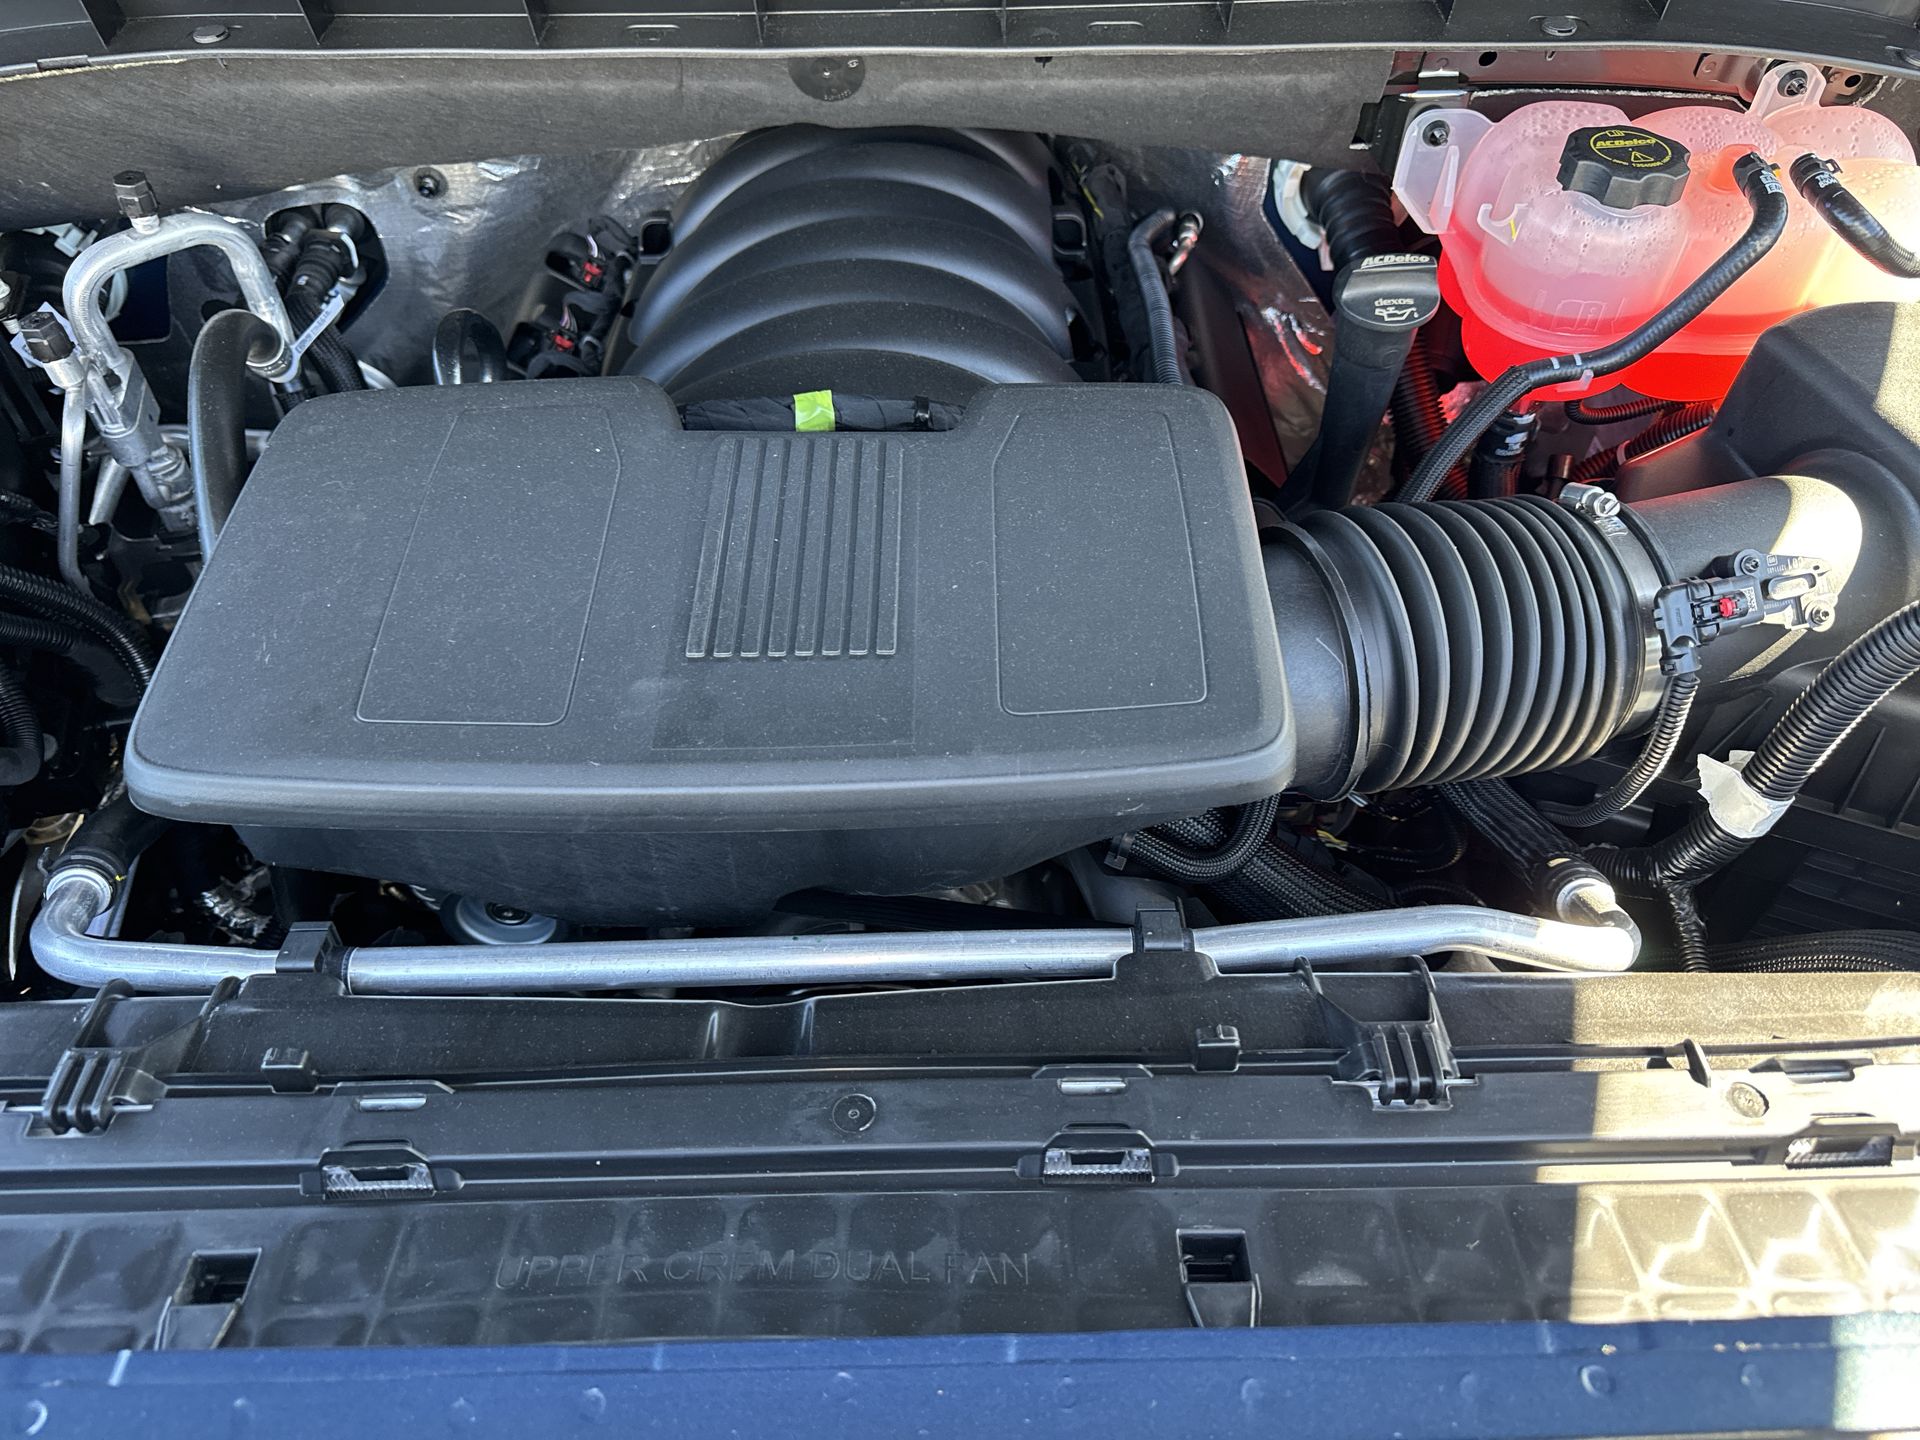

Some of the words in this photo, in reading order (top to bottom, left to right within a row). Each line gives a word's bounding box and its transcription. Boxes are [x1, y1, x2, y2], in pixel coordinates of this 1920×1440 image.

[1596, 138, 1656, 147] ACDelco
[1361, 254, 1430, 265] ACDelco
[1374, 298, 1415, 307] dexos
[495, 1253, 650, 1289] UPPER
[808, 1249, 931, 1283] DUAL
[946, 1251, 1029, 1285] FAN
